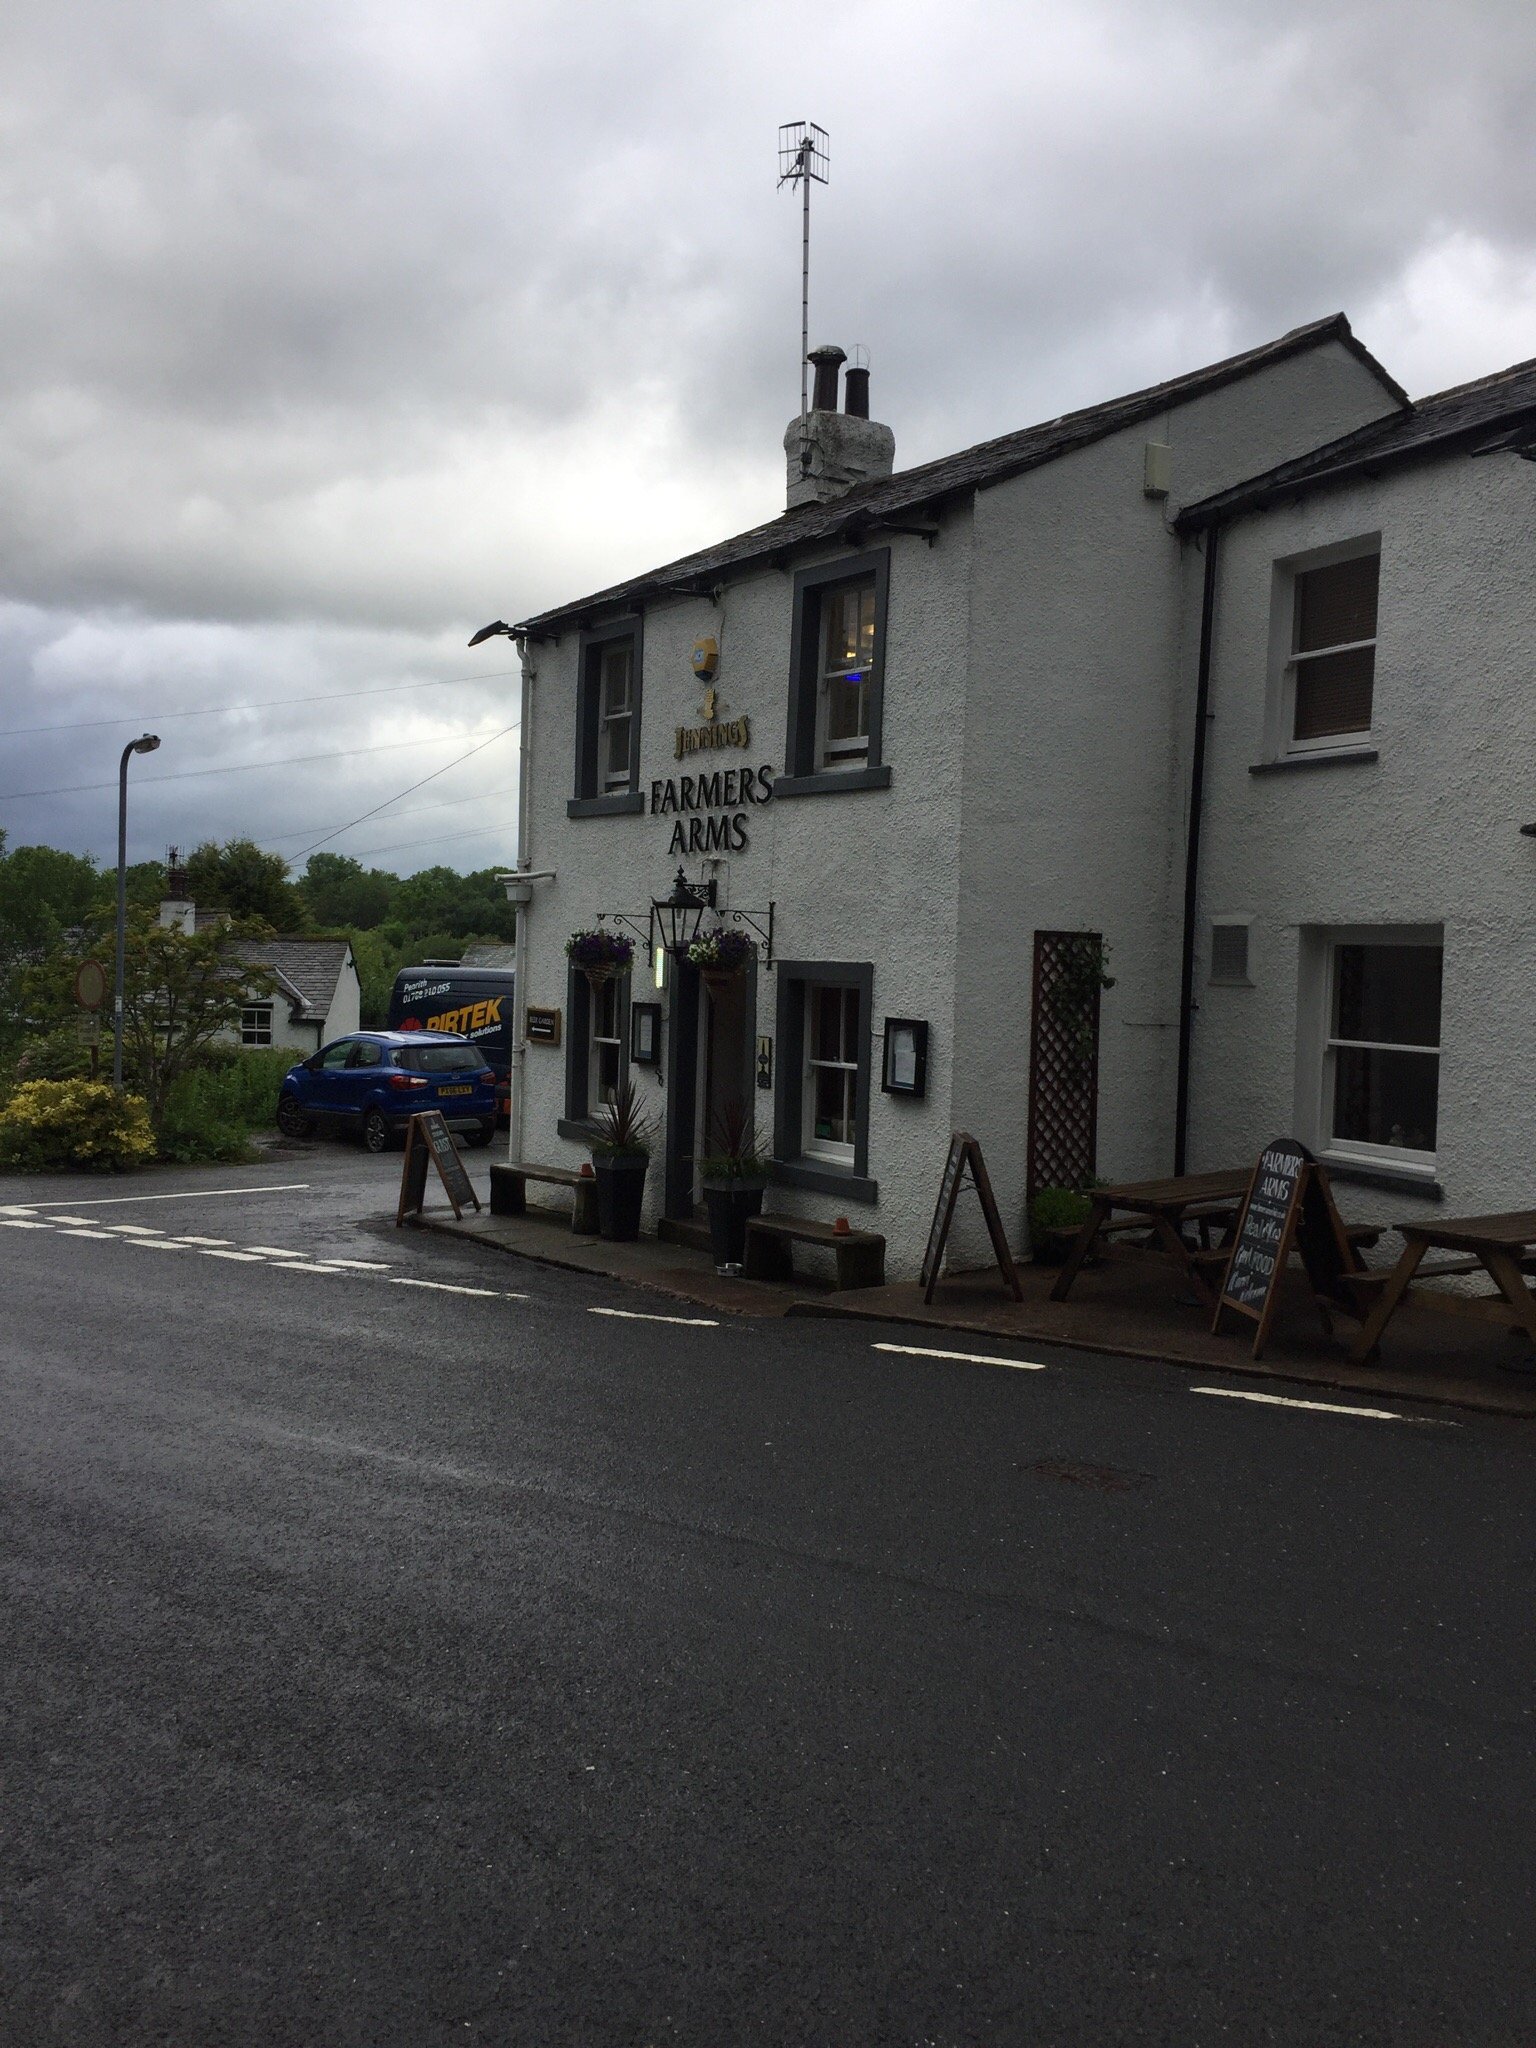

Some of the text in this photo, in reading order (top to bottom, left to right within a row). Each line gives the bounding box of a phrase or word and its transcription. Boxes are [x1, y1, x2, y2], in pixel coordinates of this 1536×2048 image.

[673, 714, 750, 761] JENNINGS
[650, 765, 773, 814] FARMERS
[667, 813, 748, 854] ARMS
[403, 978, 428, 992] Penrith
[470, 1023, 502, 1039] solutions
[1262, 1150, 1304, 1179] FARMERS
[1259, 1176, 1290, 1201] ARMS
